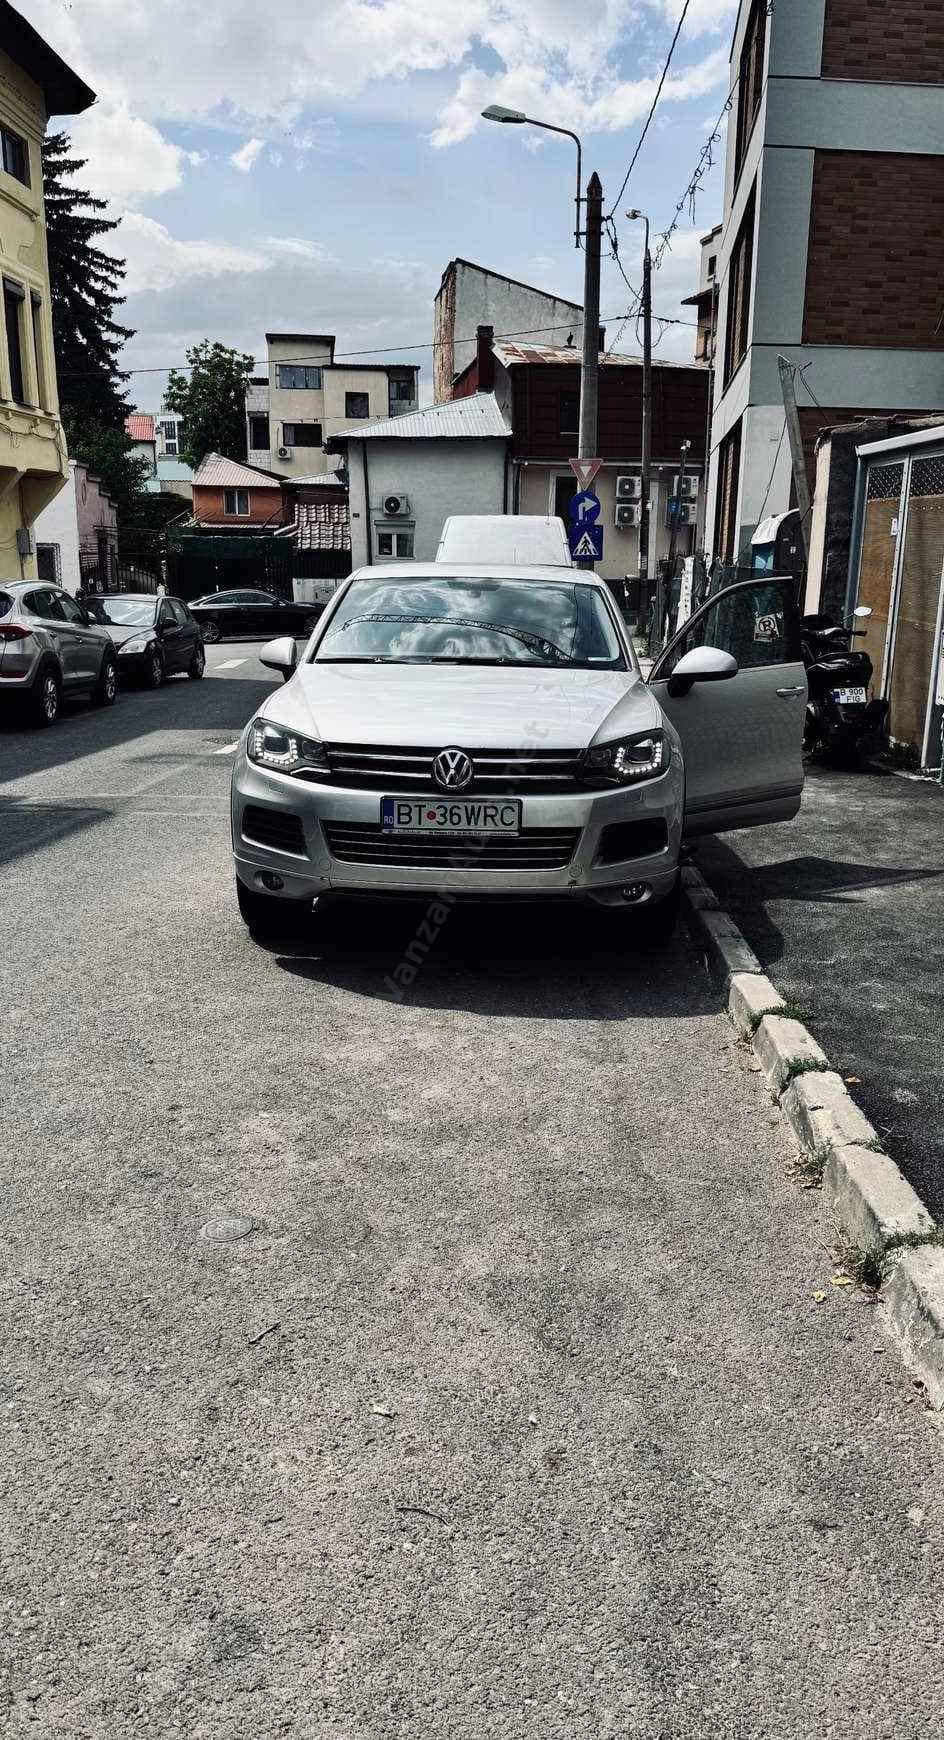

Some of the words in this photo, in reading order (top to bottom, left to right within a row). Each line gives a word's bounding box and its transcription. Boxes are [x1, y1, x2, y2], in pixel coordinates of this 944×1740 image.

[840, 688, 846, 696] B
[848, 687, 864, 696] 900
[396, 803, 427, 826] BT
[383, 815, 394, 825] RO
